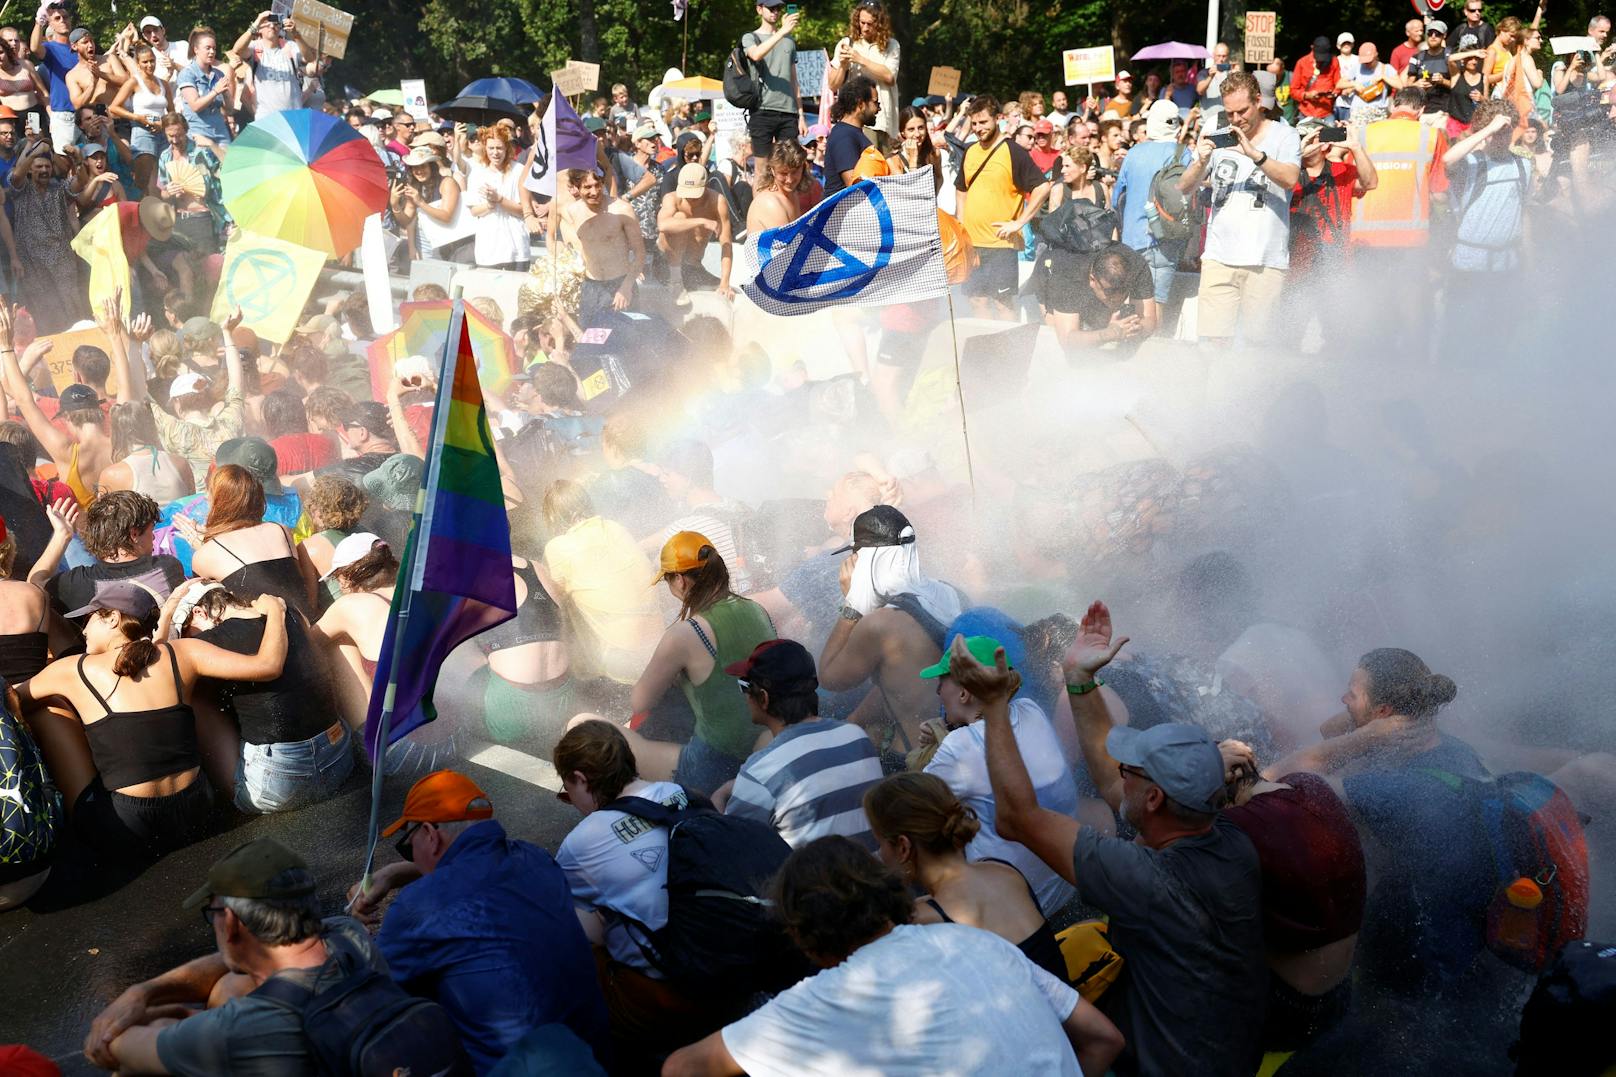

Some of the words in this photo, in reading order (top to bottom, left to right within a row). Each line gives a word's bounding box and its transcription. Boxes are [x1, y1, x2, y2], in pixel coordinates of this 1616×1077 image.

[1247, 15, 1274, 33] STOP
[1246, 35, 1274, 48] FOSSIL
[1247, 50, 1273, 62] FUEL
